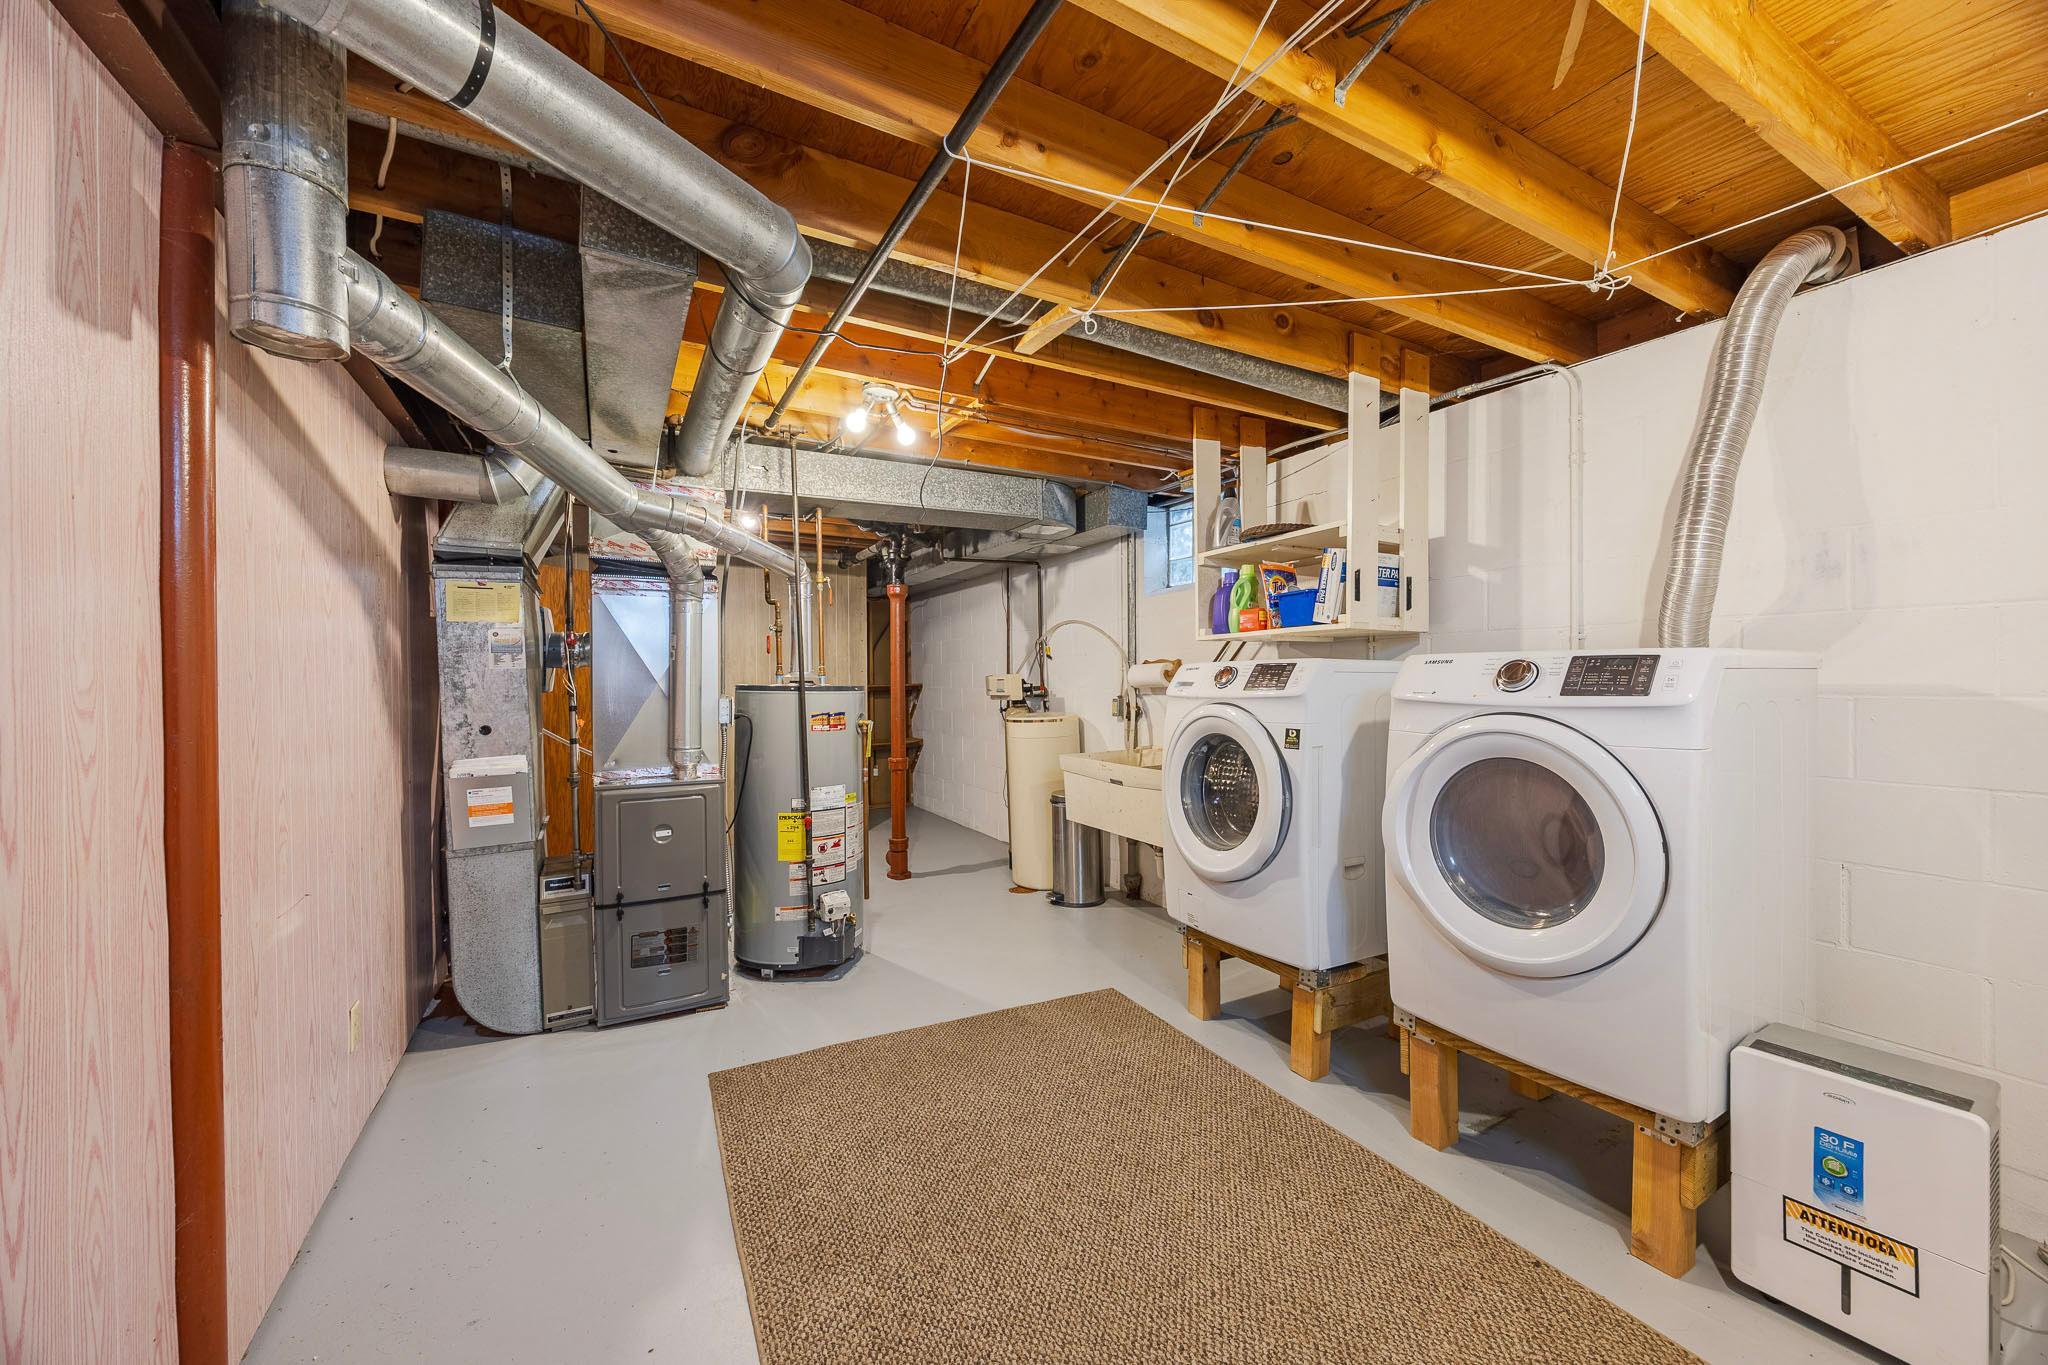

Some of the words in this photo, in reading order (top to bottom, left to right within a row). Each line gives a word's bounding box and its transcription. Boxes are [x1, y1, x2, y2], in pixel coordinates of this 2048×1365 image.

[1819, 1133, 1839, 1145] 30
[1801, 1226, 1814, 1235] The
[1815, 1232, 1843, 1247] Casters
[1844, 1245, 1856, 1253] are
[1858, 1250, 1890, 1266] included
[1892, 1263, 1899, 1271] in
[1802, 1238, 1832, 1253] removed
[1833, 1249, 1857, 1263] before
[1805, 1233, 1817, 1241] the
[1845, 1250, 1862, 1261] they
[1863, 1258, 1883, 1269] must
[1884, 1266, 1894, 1274] be
